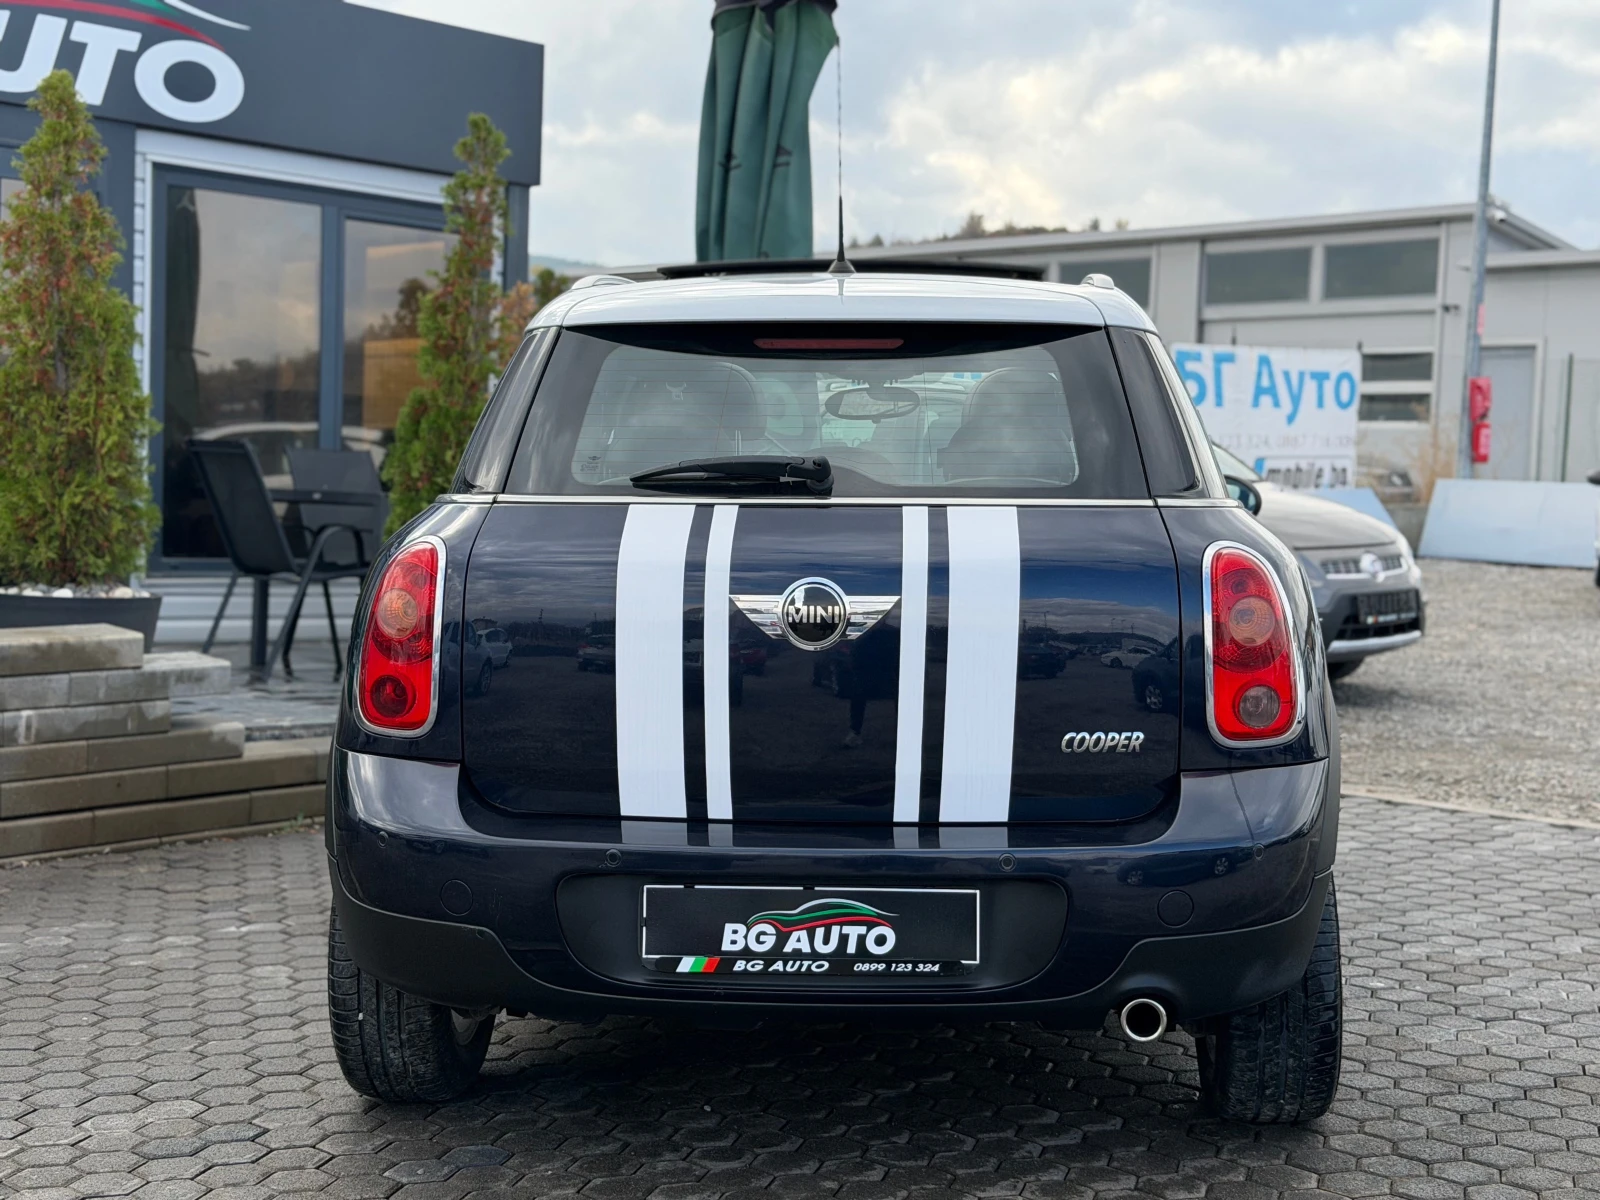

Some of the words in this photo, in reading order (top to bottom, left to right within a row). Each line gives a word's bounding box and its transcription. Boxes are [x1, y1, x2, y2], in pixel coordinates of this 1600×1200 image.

[1175, 350, 1236, 408] БГ
[1251, 354, 1357, 426] Ауто
[788, 605, 840, 624] MINI
[1060, 731, 1145, 754] COOPER
[720, 922, 777, 953] BG
[782, 924, 896, 955] AUTO
[732, 960, 765, 972] BG
[767, 960, 830, 973] AUTO
[853, 962, 887, 972] 0899
[890, 963, 913, 972] 123
[915, 963, 940, 972] 324
